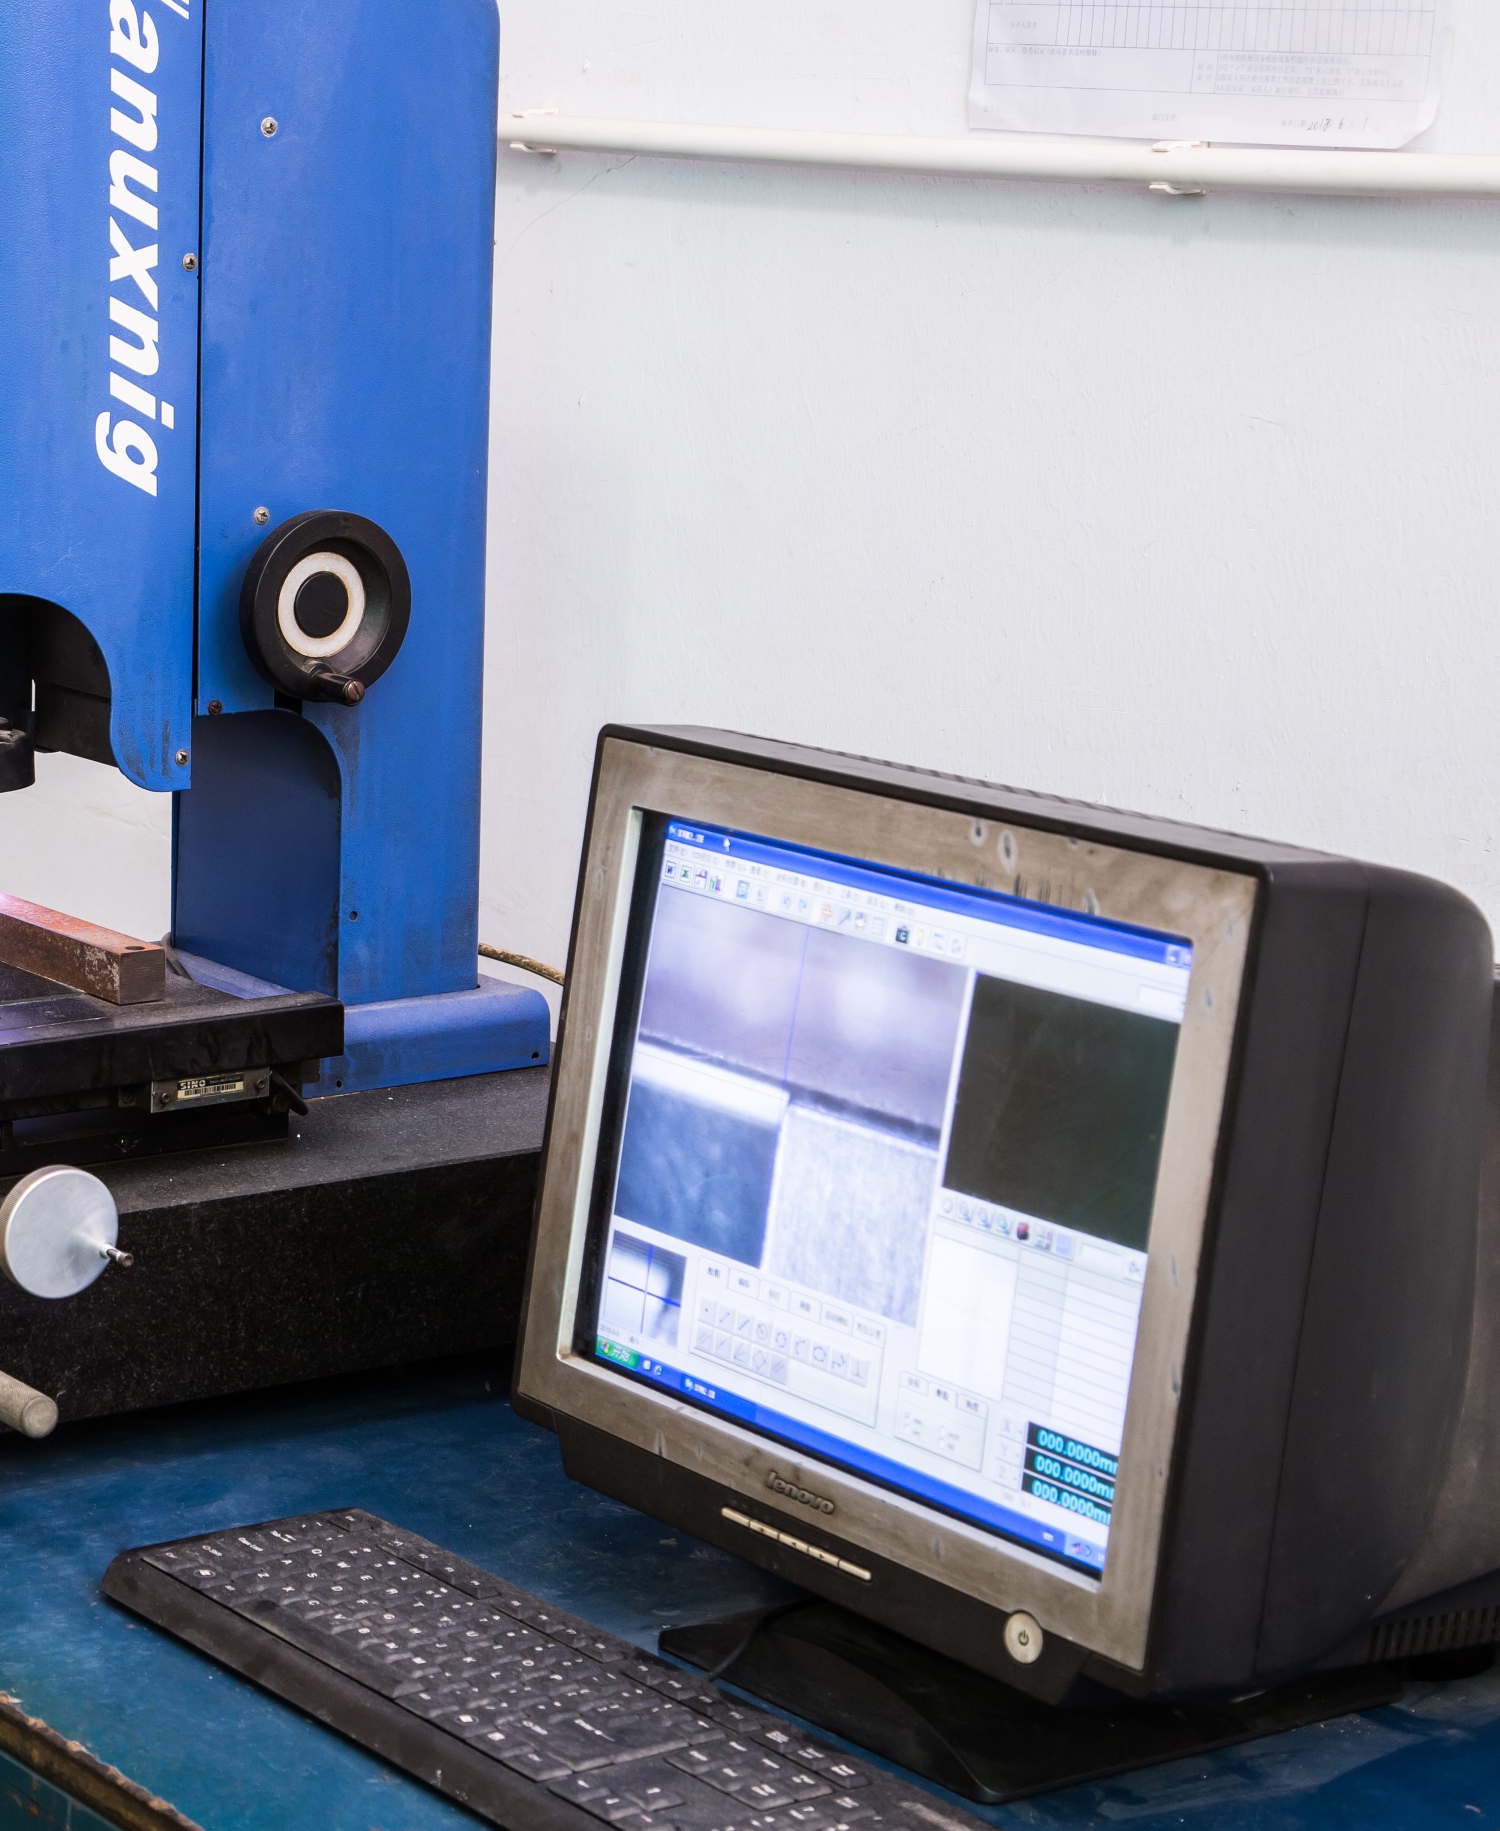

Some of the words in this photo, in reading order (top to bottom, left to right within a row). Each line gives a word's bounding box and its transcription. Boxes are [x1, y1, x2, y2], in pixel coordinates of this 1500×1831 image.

[95, 0, 190, 497] anuxnig
[180, 1079, 206, 1090] SINO
[766, 1470, 836, 1514] lenovo
